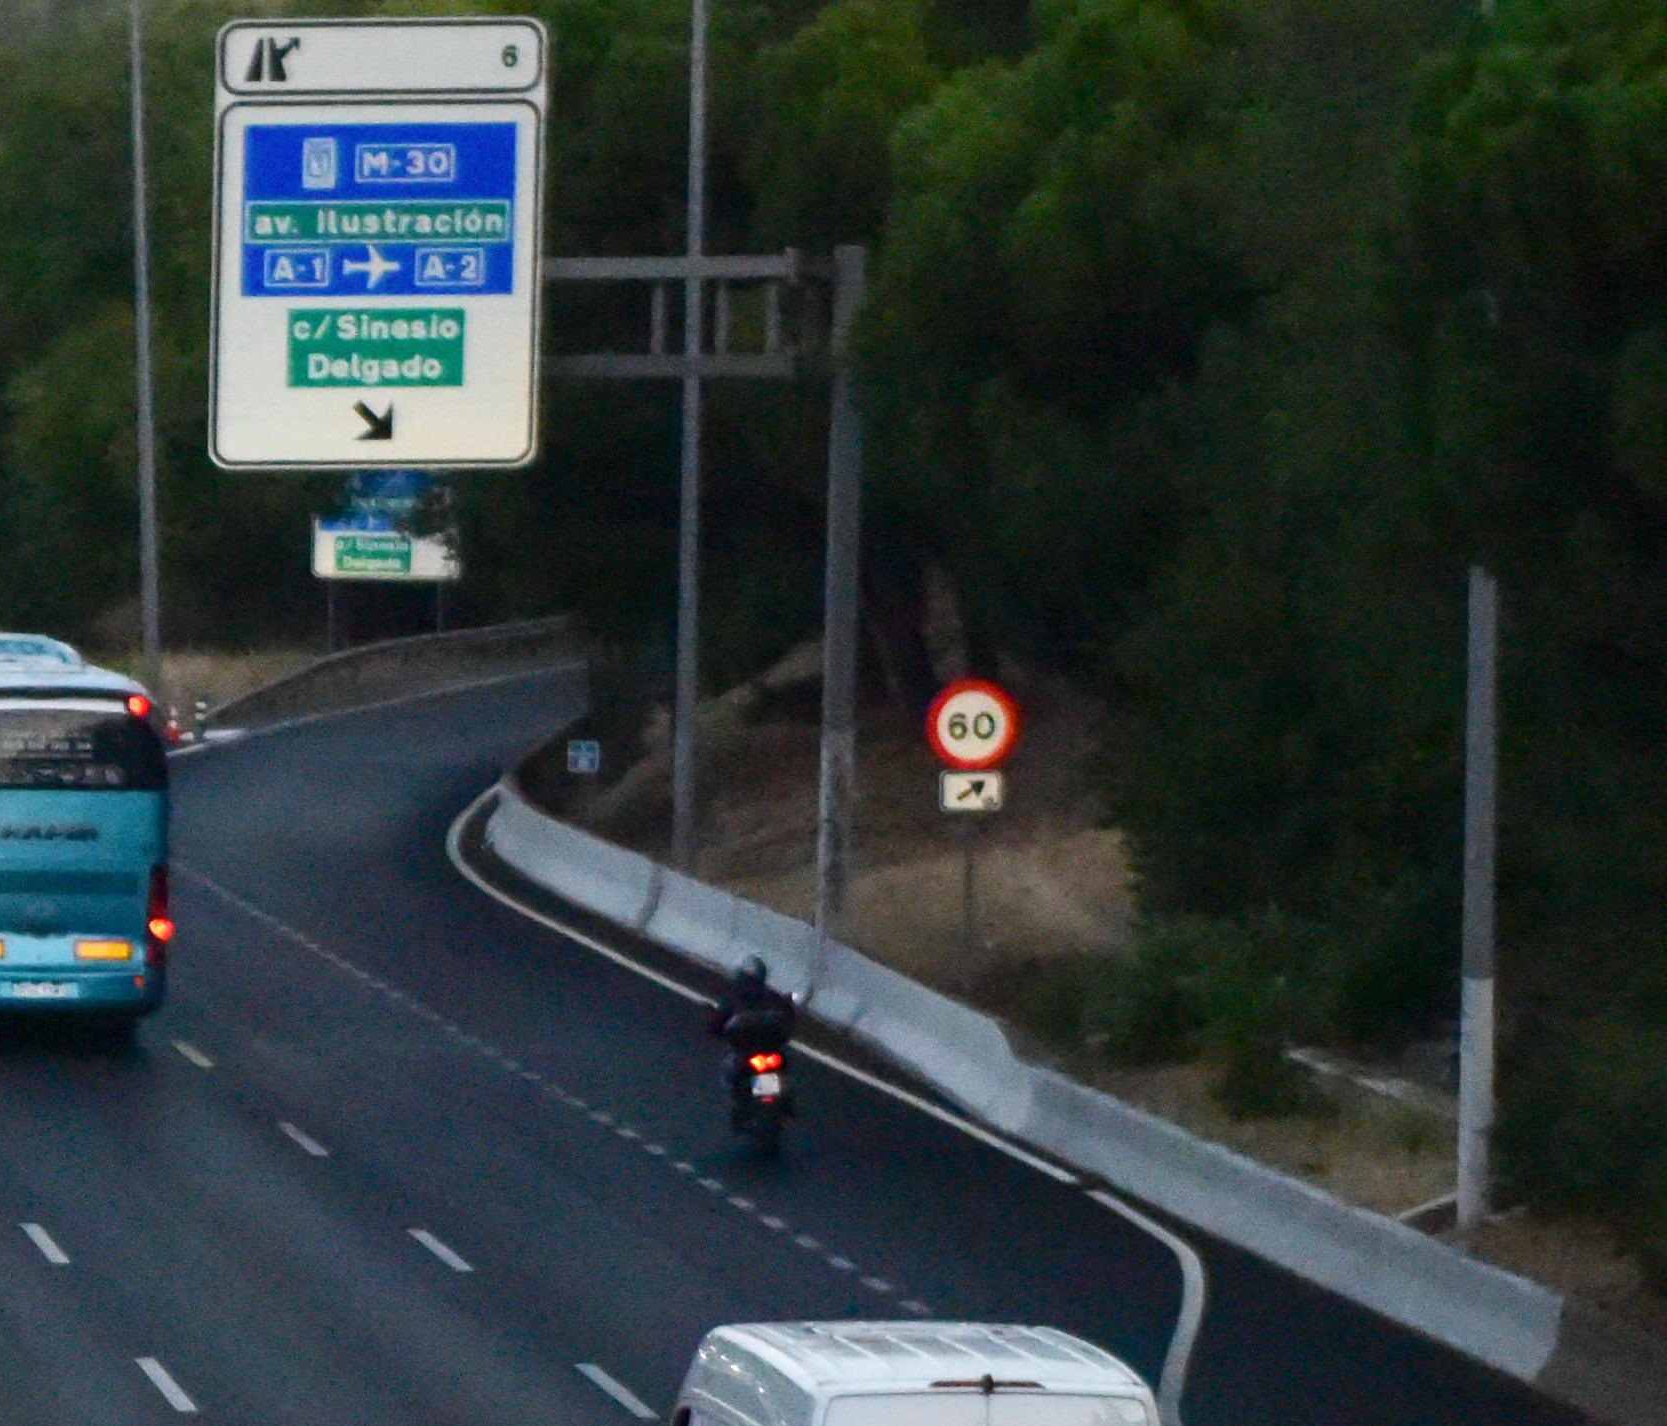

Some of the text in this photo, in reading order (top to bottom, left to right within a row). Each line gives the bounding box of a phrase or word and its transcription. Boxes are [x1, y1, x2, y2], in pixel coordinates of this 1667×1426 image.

[501, 44, 518, 67] 6
[362, 150, 449, 176] M-30
[254, 208, 504, 236] av. Ilustración
[273, 255, 324, 281] A-1
[423, 254, 477, 280] A-2
[307, 352, 443, 384] Delgado
[949, 711, 995, 740] 60
